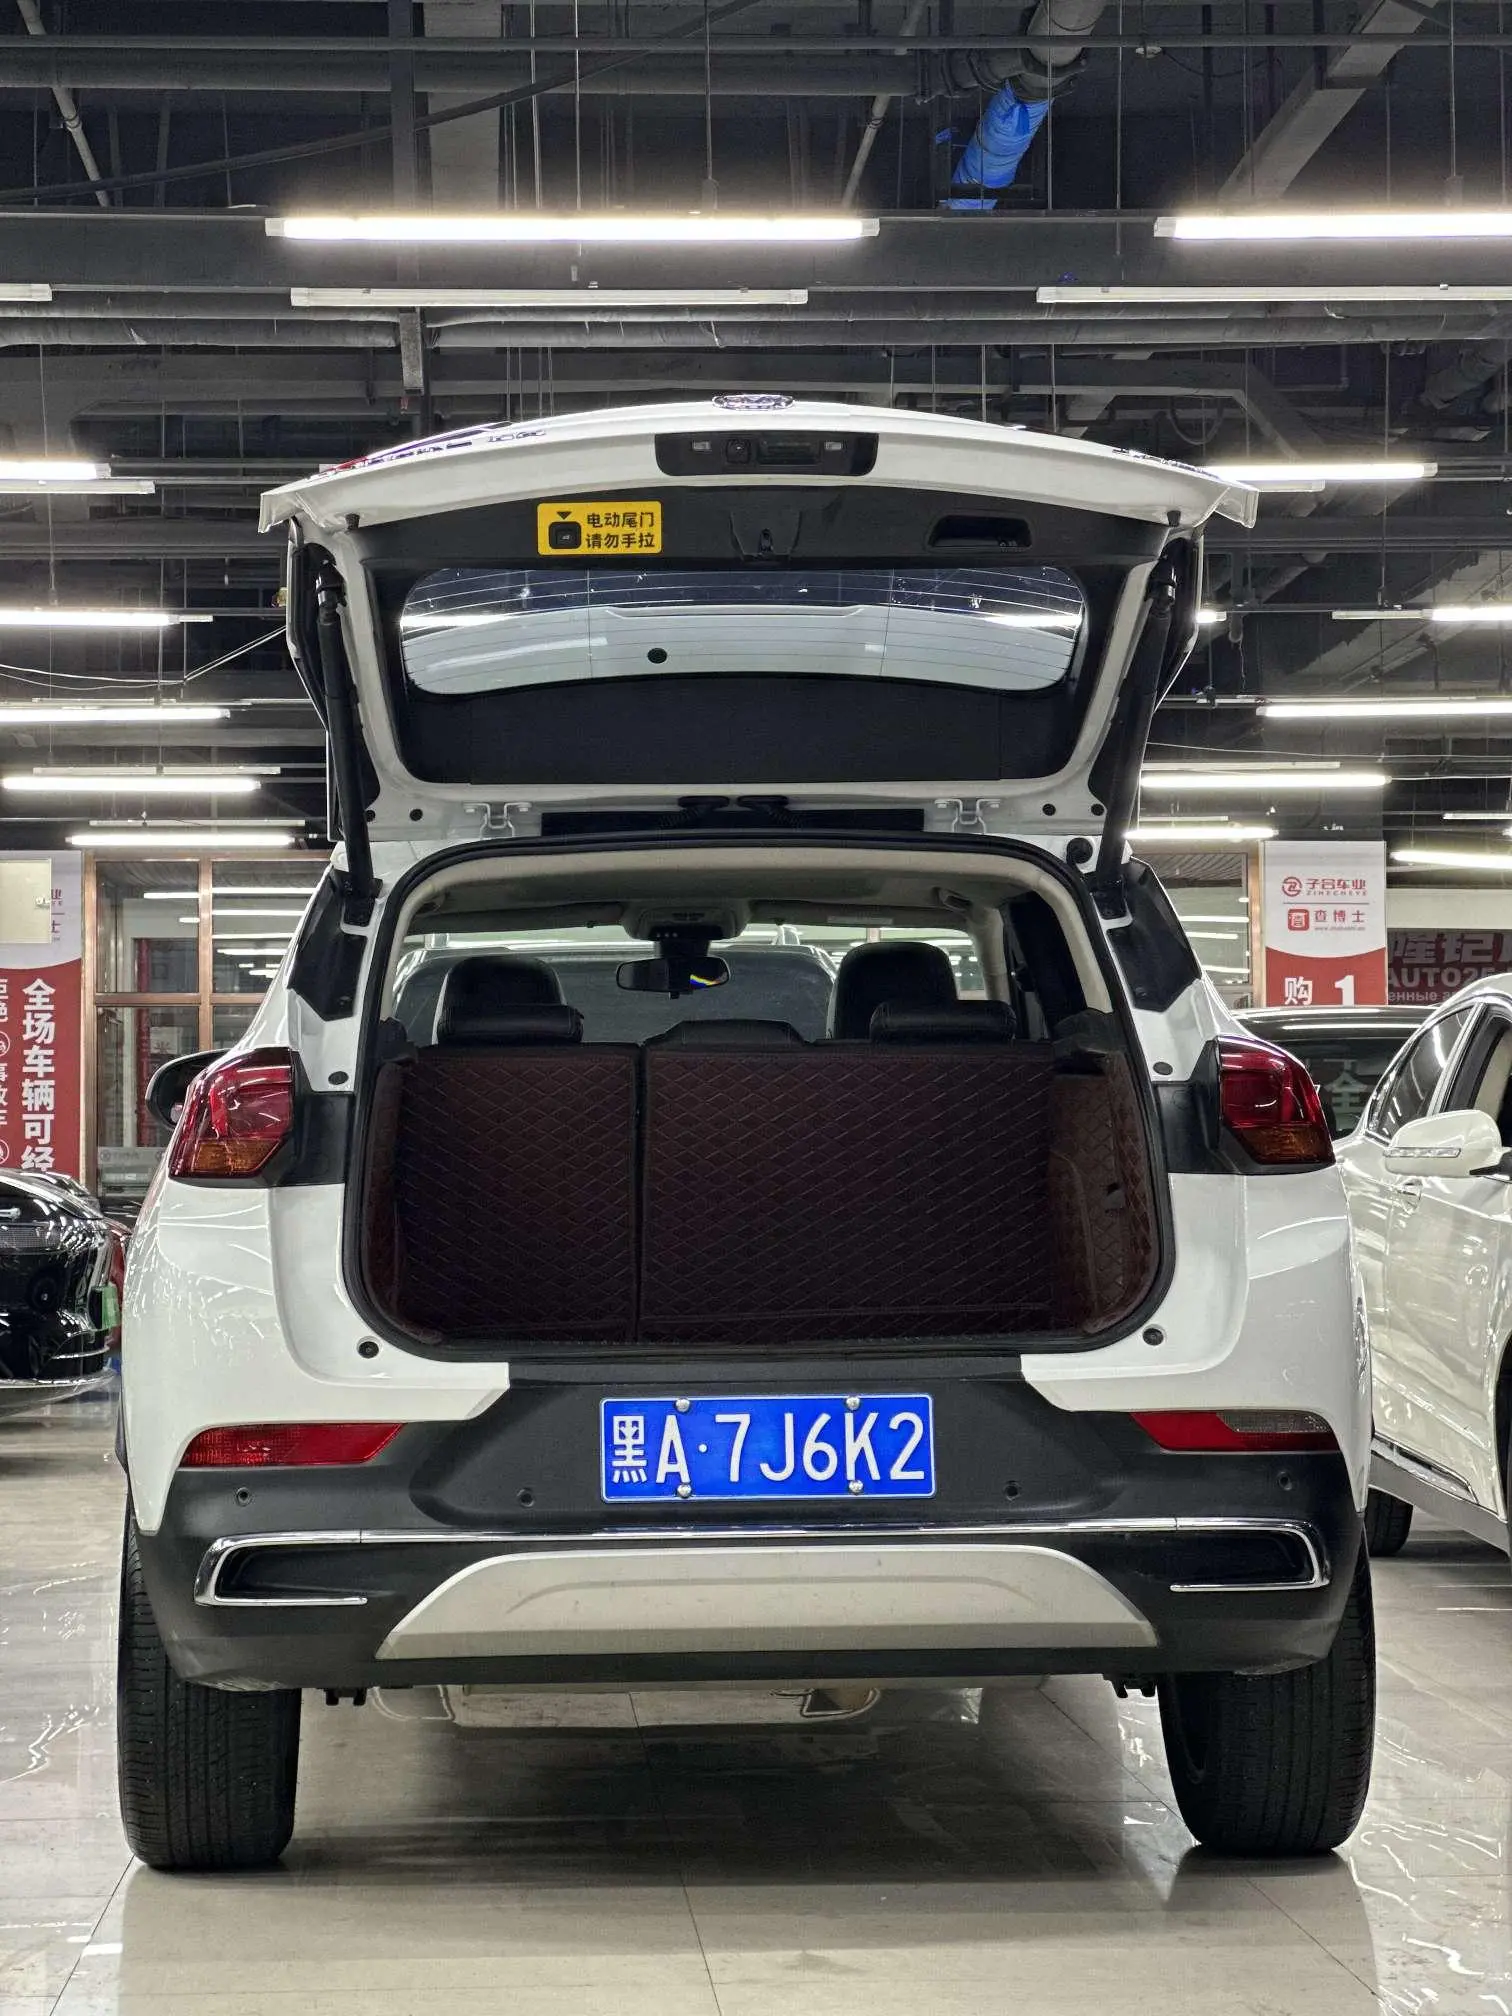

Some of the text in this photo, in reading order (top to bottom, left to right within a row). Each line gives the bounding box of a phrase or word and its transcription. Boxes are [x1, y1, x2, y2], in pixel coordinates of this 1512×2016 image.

[587, 511, 655, 528] 电动尾门
[585, 532, 656, 549] 请勿手拉
[1314, 909, 1366, 923] 查博士
[21, 978, 56, 1172] 全场车辆可经
